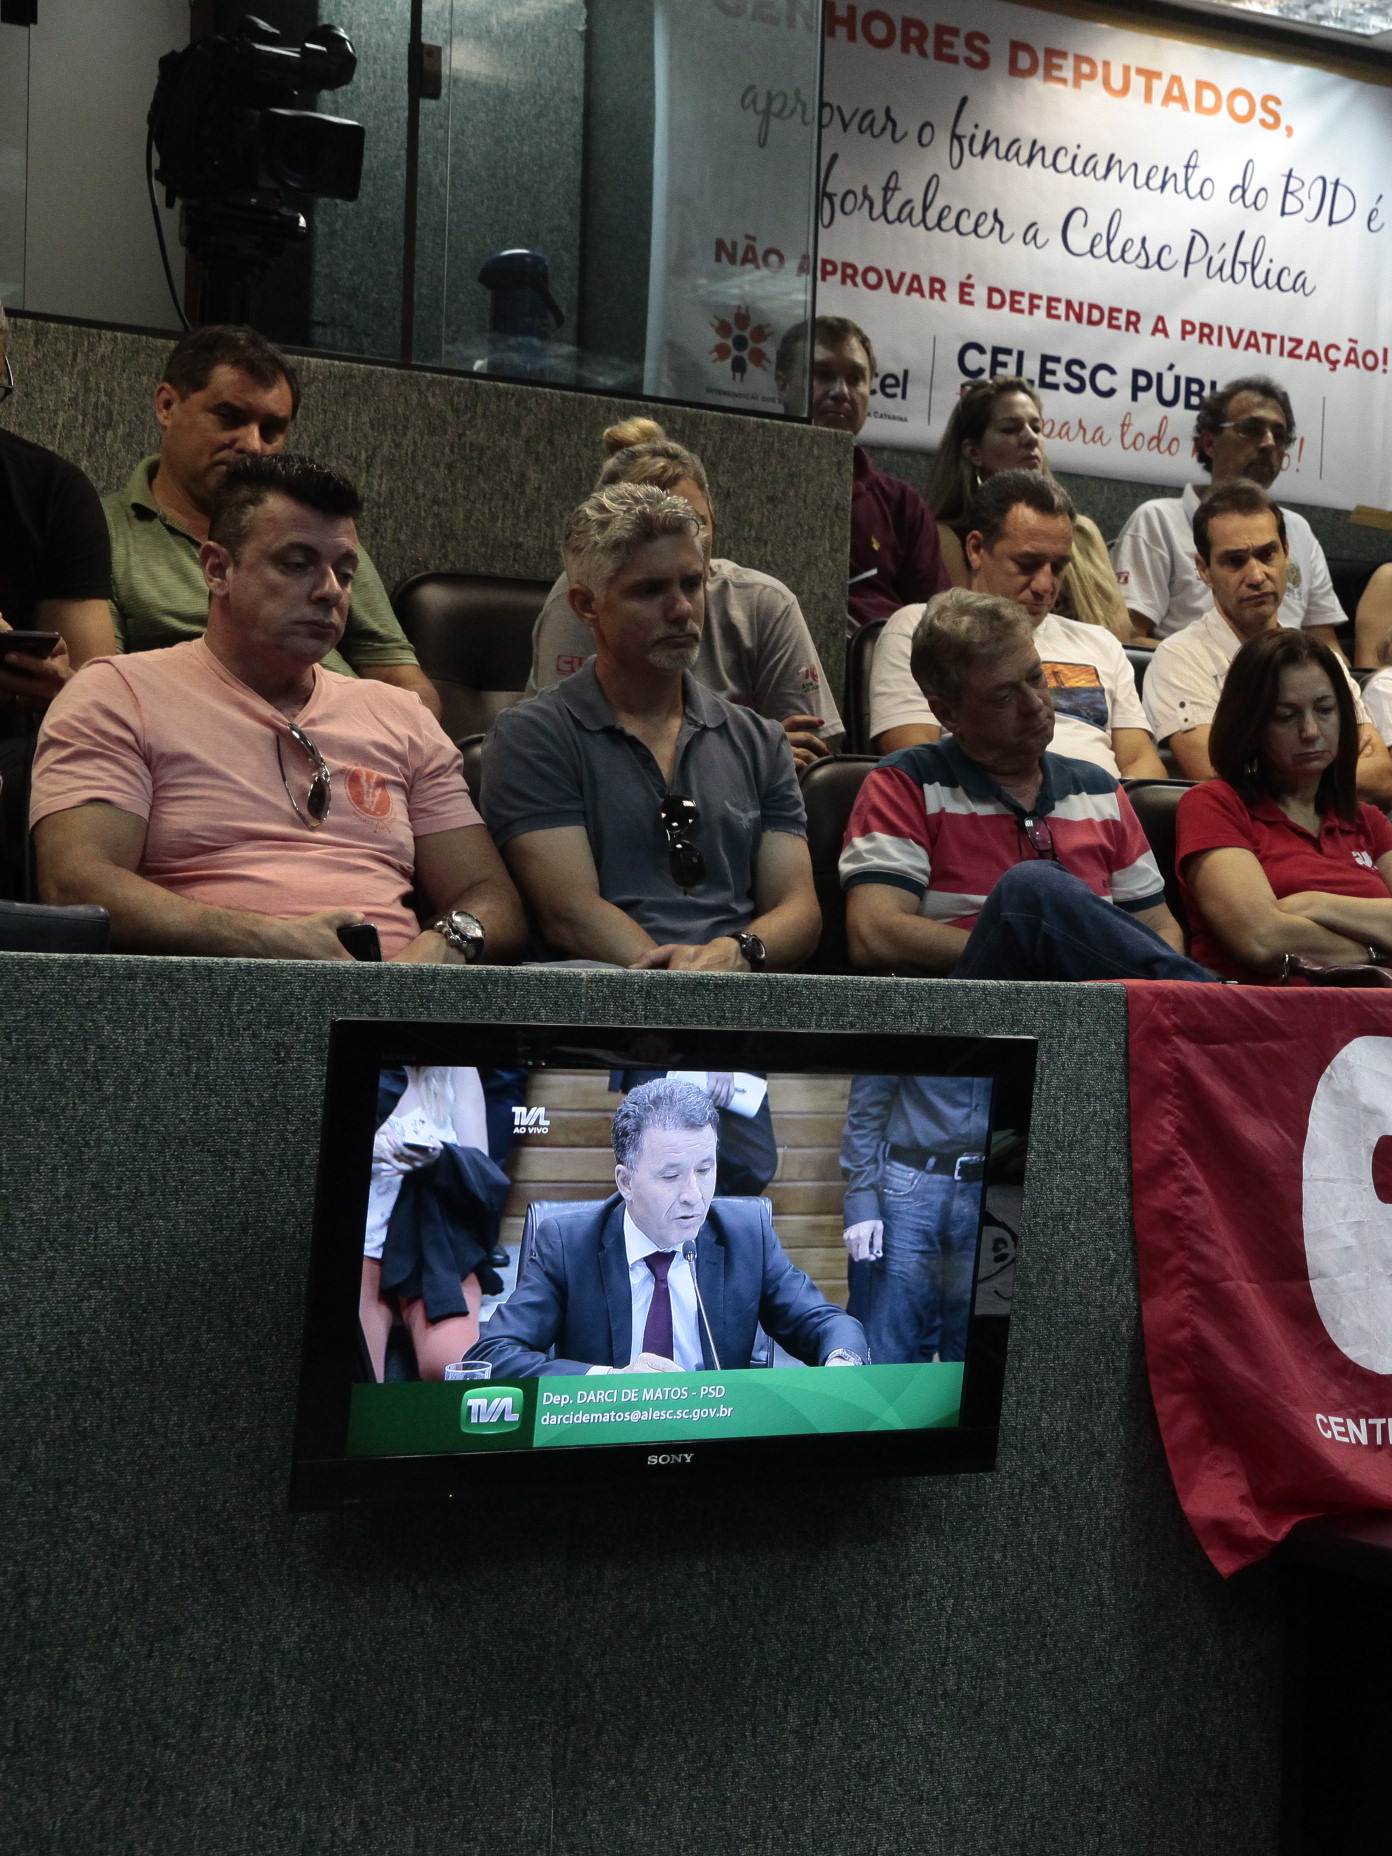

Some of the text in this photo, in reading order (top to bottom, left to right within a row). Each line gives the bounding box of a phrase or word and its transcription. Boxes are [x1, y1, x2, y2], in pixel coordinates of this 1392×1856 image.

[1007, 37, 1294, 138] DEPUTADOS,
[740, 83, 908, 149] aprovar
[917, 121, 935, 148] o
[949, 95, 1216, 202] financiamento
[1228, 158, 1269, 212] do
[1366, 193, 1385, 234] é
[820, 152, 1317, 298] fortalecer a Celesc Pública
[714, 234, 1389, 374] NÃO APROVAR É DEFENDER A PRIVATIZAÇÃO!
[957, 341, 1119, 399] CELESC
[1119, 411, 1181, 456] todo
[512, 1126, 549, 1134] AO VIVO
[540, 1404, 734, 1425] darcidematos@alesc.sc.gov.br
[542, 1391, 574, 1407] Dep.
[577, 1389, 618, 1404] DARCI
[622, 1388, 640, 1403] DE
[642, 1386, 689, 1402] MATOS
[700, 1384, 727, 1399] PSD
[646, 1453, 695, 1466] SONY
